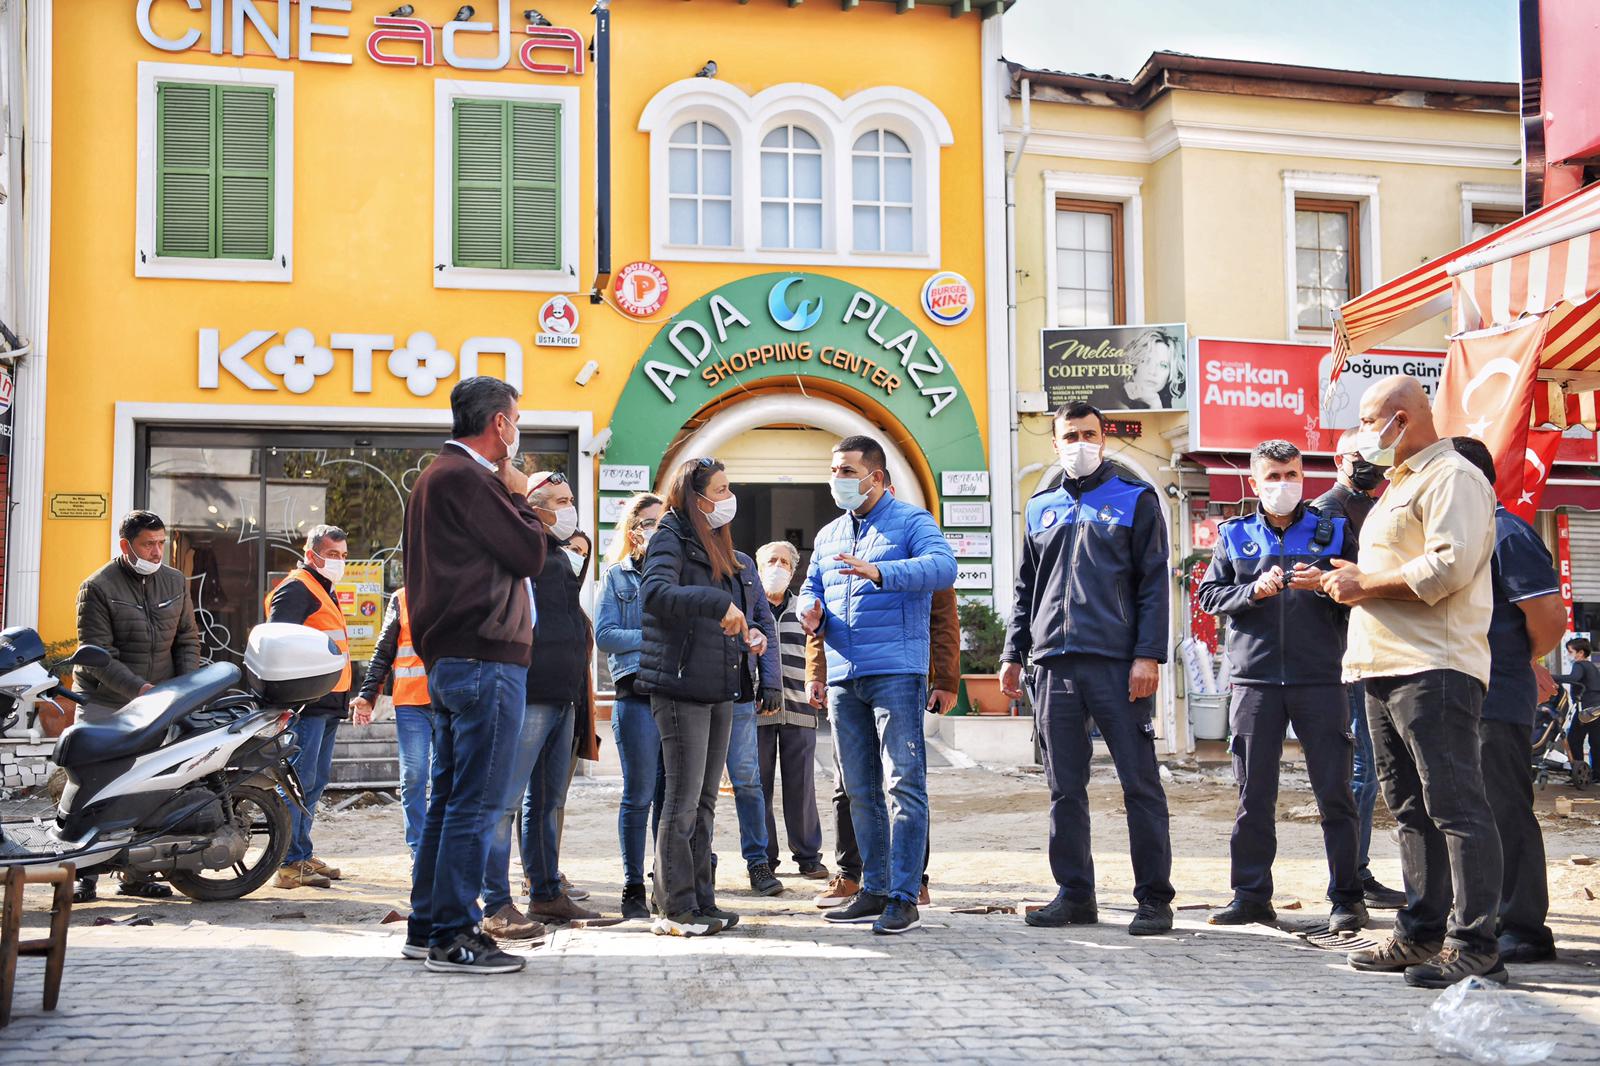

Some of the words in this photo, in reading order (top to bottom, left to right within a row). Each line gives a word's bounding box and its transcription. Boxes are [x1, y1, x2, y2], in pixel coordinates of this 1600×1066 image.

[931, 285, 967, 297] BURGER
[931, 293, 967, 309] KING
[643, 294, 752, 403] ADA
[842, 291, 958, 417] PLAZA
[1048, 340, 1125, 360] Melisa
[702, 341, 813, 388] SHOPPING
[820, 346, 902, 395] CENTER
[1048, 363, 1134, 378] COIFFEUR
[1205, 360, 1289, 385] Serkan
[1204, 384, 1304, 415] Ambalaj
